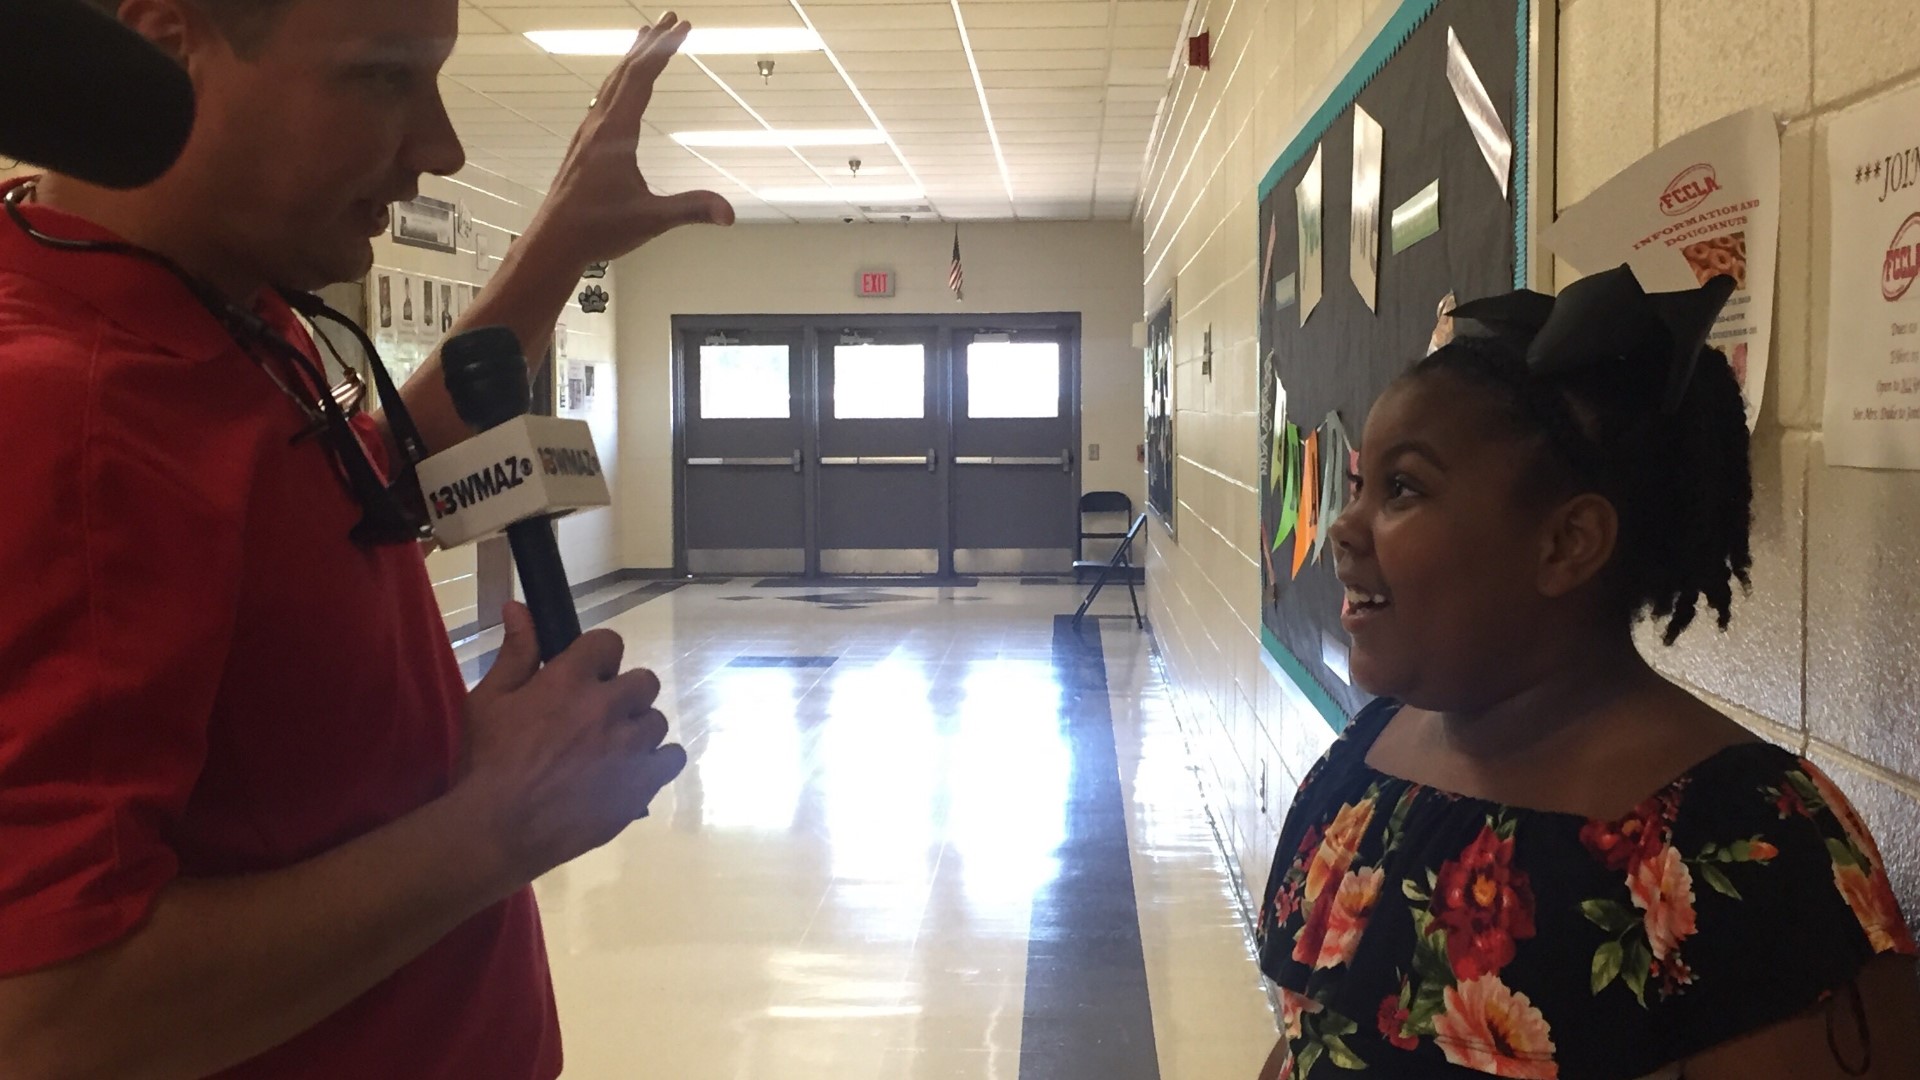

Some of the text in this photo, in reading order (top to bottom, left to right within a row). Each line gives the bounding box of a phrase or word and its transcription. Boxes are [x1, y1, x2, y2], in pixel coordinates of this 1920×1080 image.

[1660, 177, 1720, 209] FCCLA
[1632, 199, 1760, 251] INFORMATION AND
[1664, 216, 1748, 248] DOUGHNUTS
[863, 272, 887, 293] EXIT
[537, 447, 595, 476] 13WMAZ
[429, 456, 523, 519] 13WMAZ
